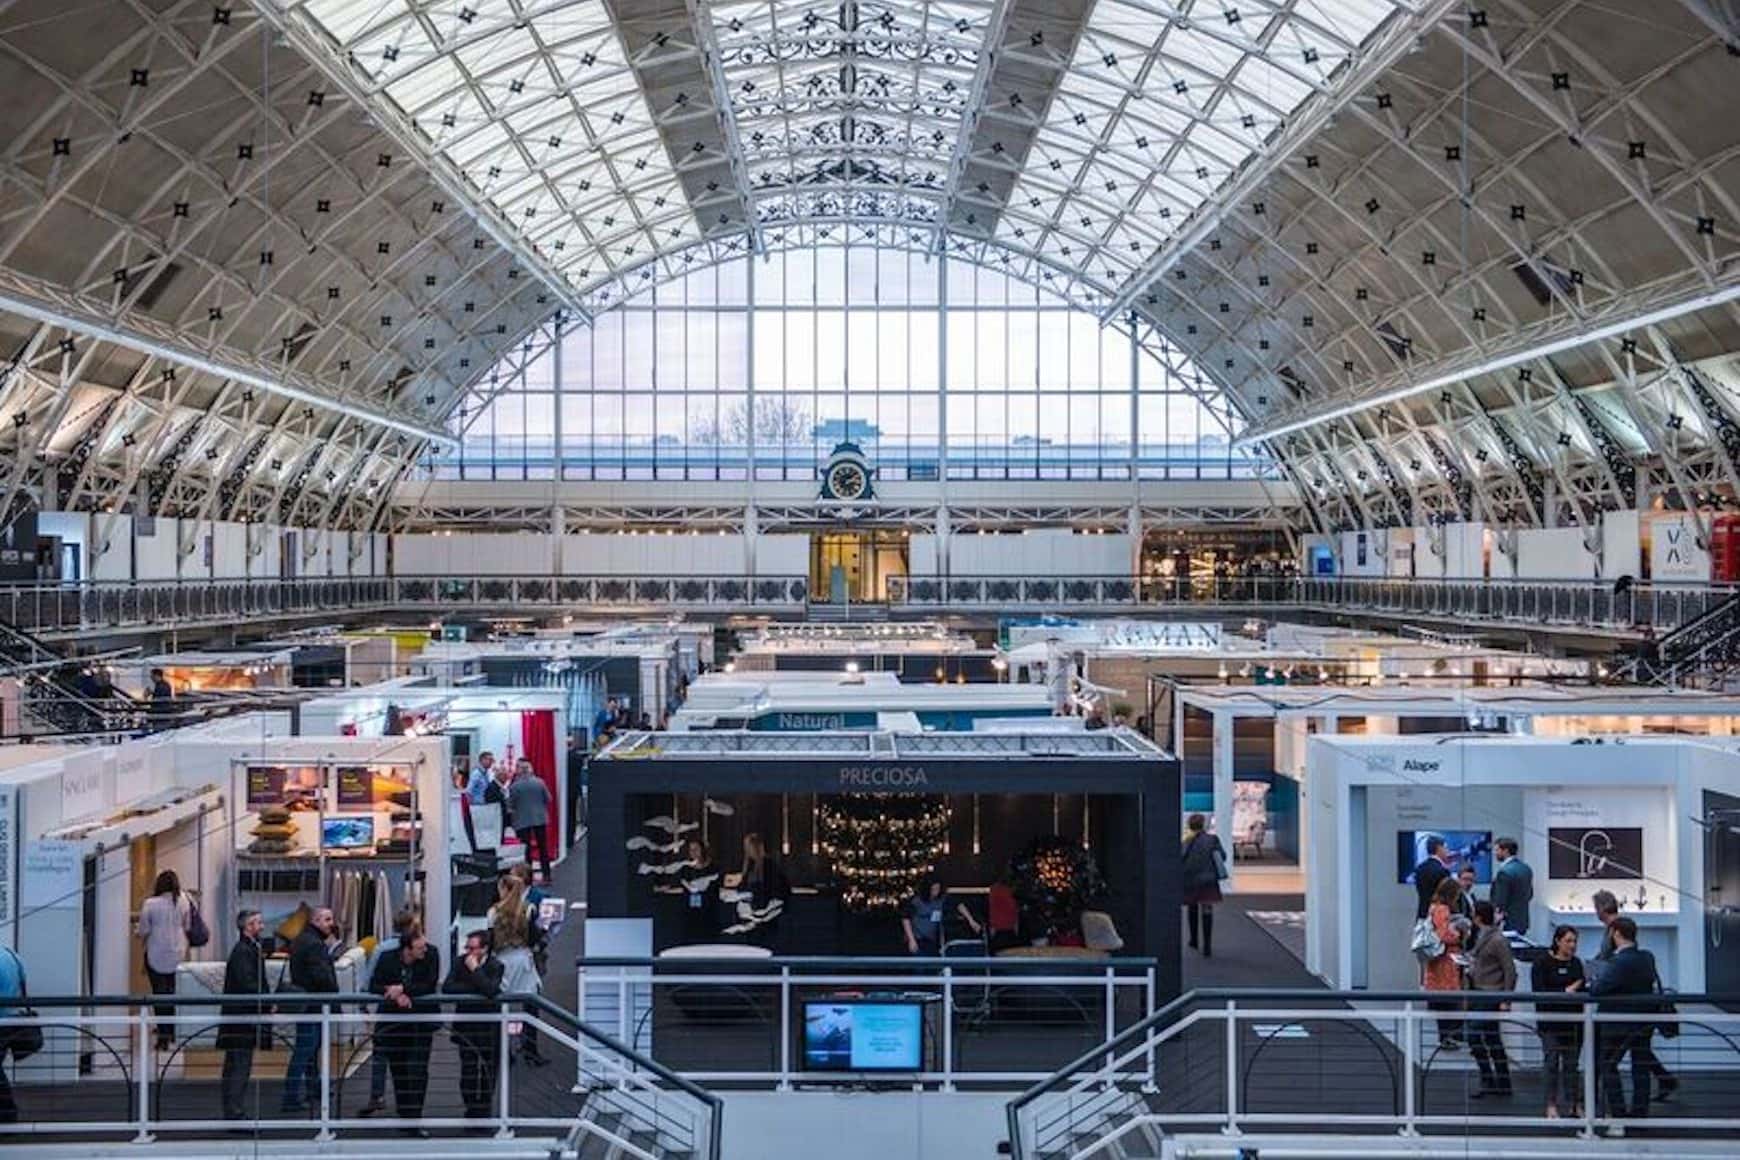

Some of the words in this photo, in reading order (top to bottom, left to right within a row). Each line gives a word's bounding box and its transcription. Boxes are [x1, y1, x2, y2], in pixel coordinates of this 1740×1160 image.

[779, 712, 845, 729] Natural
[1403, 759, 1440, 773] Alape
[839, 767, 928, 785] PRECIOSA
